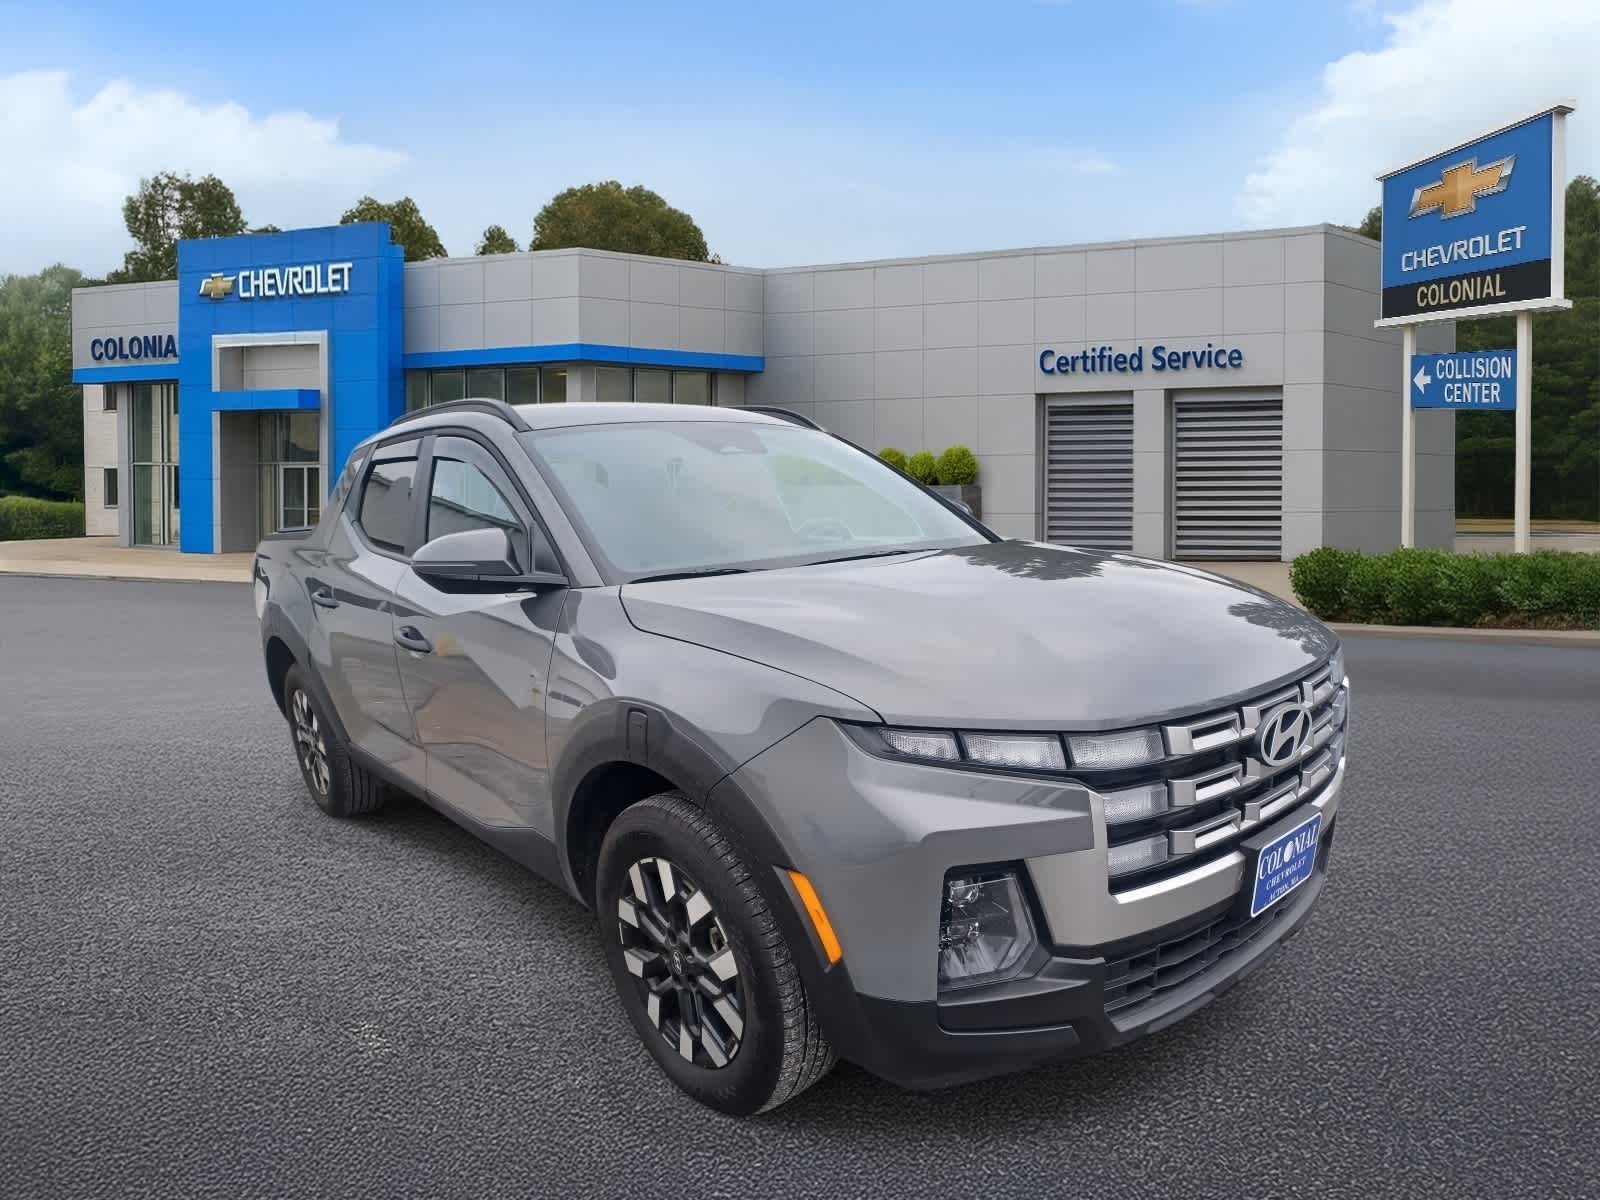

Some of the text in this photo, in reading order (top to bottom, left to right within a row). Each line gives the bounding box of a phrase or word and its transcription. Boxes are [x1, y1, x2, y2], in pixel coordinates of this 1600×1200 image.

[1401, 225, 1527, 272] CHEVROLET
[238, 262, 353, 298] CHEVROLET
[1416, 273, 1506, 307] COLONIAL
[91, 334, 179, 361] COLONIA
[1039, 343, 1243, 375] Certified Service
[1436, 356, 1512, 380] COLLISION
[1444, 382, 1501, 403] CENTER
[1260, 824, 1318, 879] COLONIAL
